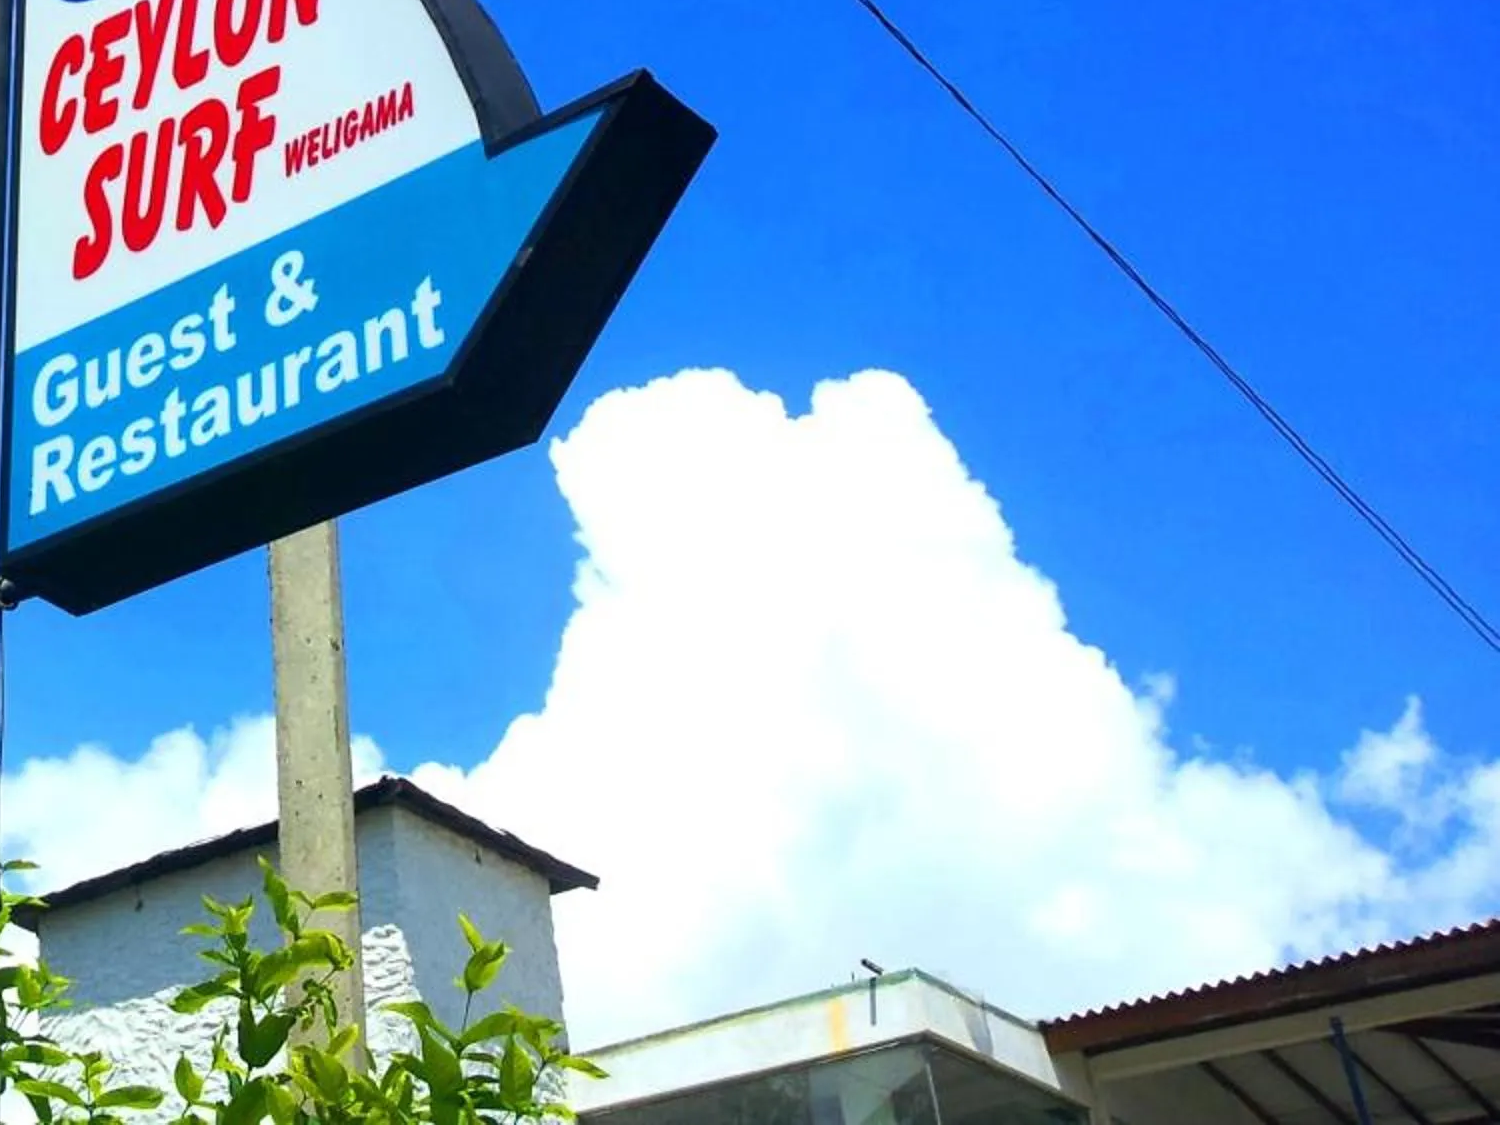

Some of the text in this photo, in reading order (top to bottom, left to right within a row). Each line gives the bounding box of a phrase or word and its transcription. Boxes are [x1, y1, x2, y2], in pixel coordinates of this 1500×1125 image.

[72, 65, 415, 281] SURF WELIGAMA
[28, 276, 445, 516] Restaurant
[32, 249, 319, 428] Guest &
